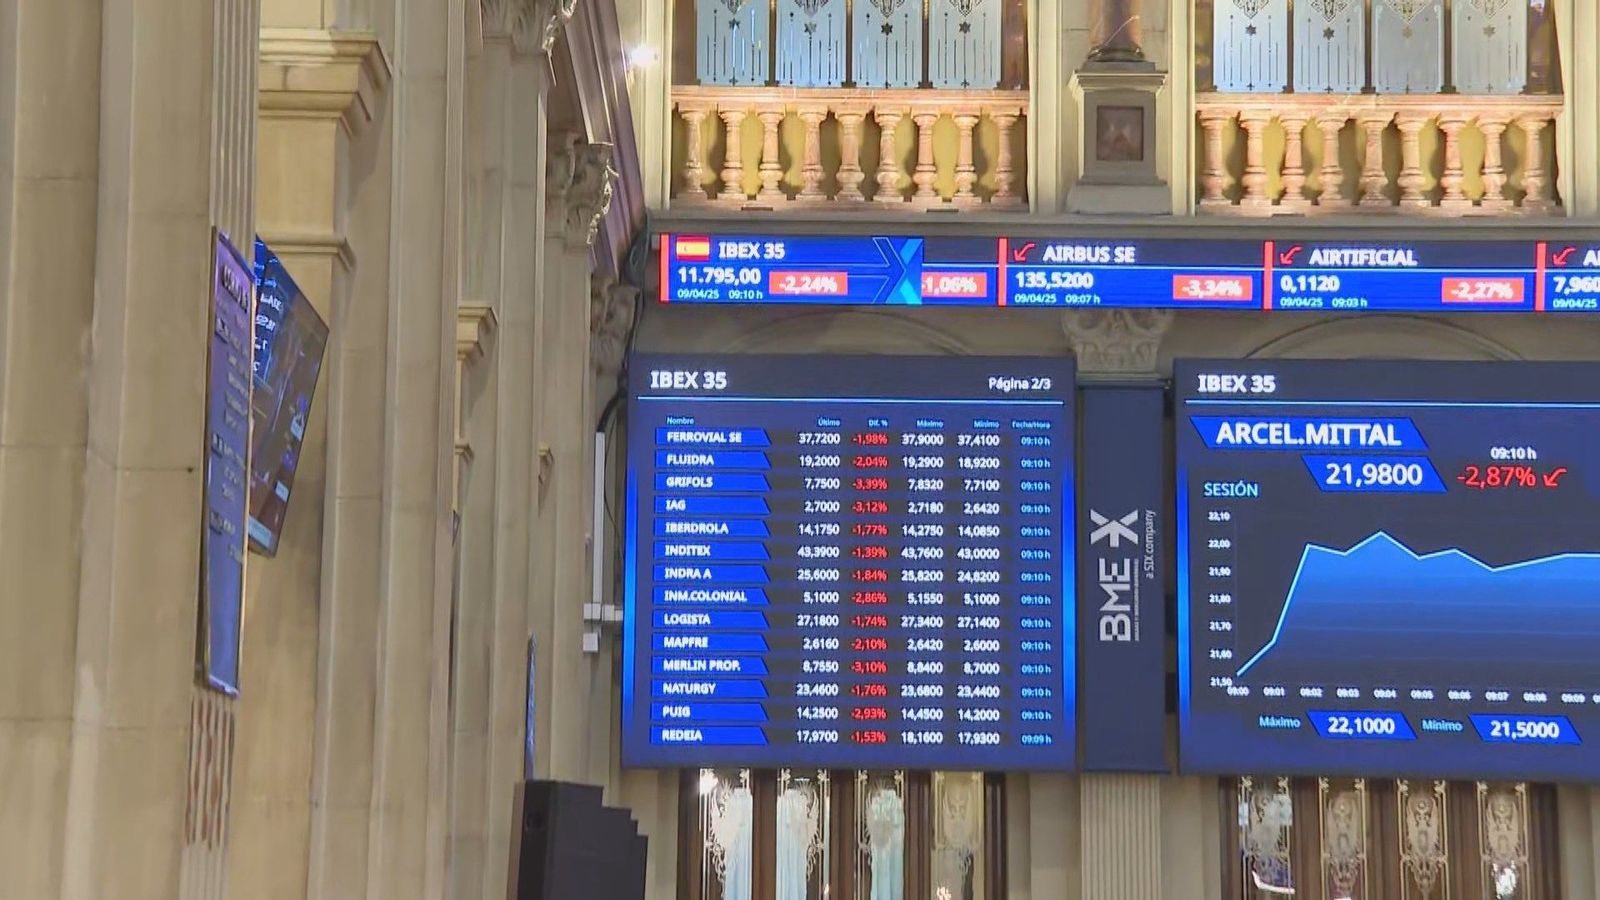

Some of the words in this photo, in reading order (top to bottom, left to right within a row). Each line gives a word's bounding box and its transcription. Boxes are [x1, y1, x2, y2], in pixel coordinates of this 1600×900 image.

[719, 242, 760, 258] IBEX
[764, 243, 785, 259] 35
[1043, 246, 1110, 262] AIRBUS
[1114, 247, 1135, 262] SE
[1309, 249, 1417, 265] AIRTIFICIAL
[679, 267, 761, 285] 11.795,00
[1016, 272, 1093, 289] 135,5200
[1281, 276, 1340, 293] 0,1120
[779, 276, 837, 294] -2,24%
[1183, 280, 1242, 298] -3,34%
[1452, 282, 1513, 301] -2,27%
[677, 288, 720, 300] 09/04/25
[728, 289, 755, 300] 09:10
[756, 289, 764, 300] h
[1014, 293, 1057, 304] 09/04/25
[1065, 293, 1092, 304] 09:07
[1093, 294, 1101, 304] h
[1279, 296, 1324, 308] 09/04/25
[1331, 297, 1360, 308] 09:03
[1360, 297, 1368, 307] h
[1552, 298, 1598, 308] 09/04/25
[651, 371, 698, 388] IBEX
[703, 372, 726, 389] 35
[989, 377, 1029, 392] Página
[1031, 377, 1052, 390] 2/3
[1198, 375, 1246, 392] IBEX
[1251, 375, 1275, 392] 35
[666, 416, 695, 425] Nombre
[817, 417, 841, 427] Último
[916, 419, 944, 428] Máximo
[666, 431, 727, 443] FERROVIAL
[728, 431, 742, 443] SE
[798, 432, 841, 446] 37,7200
[901, 433, 944, 446] 37,9000
[957, 434, 1000, 447] 37,4100
[1021, 436, 1044, 446] 09:10
[1216, 423, 1401, 445] ARCEL.MITTAL
[666, 453, 715, 466] FLUIDRA
[799, 455, 841, 468] 19,2000
[902, 456, 944, 470] 19,2900
[958, 456, 1000, 470] 18,9200
[1021, 459, 1044, 468] 09:10
[1490, 446, 1526, 460] 09:10
[1526, 446, 1537, 460] h
[666, 476, 714, 488] GRIFOLS
[804, 477, 841, 490] 7,7500
[964, 479, 1000, 492] 7,7100
[1020, 481, 1044, 491] 09:10
[1327, 464, 1422, 487] 21,9800
[1458, 467, 1536, 488] -2,87%
[1205, 481, 1257, 496] SESIÓN
[665, 499, 687, 511] IAG
[804, 500, 840, 513] 2,7000
[963, 502, 1000, 515] 2,6420
[1020, 504, 1044, 514] 09:10
[665, 521, 729, 535] IBERDROLA
[798, 523, 840, 537] 14,1750
[1021, 527, 1044, 536] 09:10
[1145, 509, 1157, 554] company
[664, 544, 711, 556] INDITEX
[797, 546, 840, 559] 43,3900
[901, 546, 944, 560] 43,7600
[956, 547, 1000, 561] 43,0000
[1020, 550, 1044, 559] 09:10
[1143, 554, 1155, 571] SIX
[664, 567, 702, 579] INDRA
[702, 568, 712, 579] A
[797, 568, 840, 582] 25,6000
[1021, 573, 1044, 582] 09:10
[664, 590, 748, 602] INM.COLONIAL
[803, 591, 840, 605] 5,1000
[907, 592, 944, 605] 5,1550
[963, 593, 1000, 606] 5,1000
[1020, 595, 1044, 605] 09:10
[1099, 558, 1130, 641] BME
[664, 613, 711, 625] LOGISTA
[797, 614, 840, 628] 27,1800
[900, 615, 944, 628] 27,3400
[957, 616, 1000, 630] 27,1400
[1021, 618, 1044, 628] 09:10
[663, 636, 709, 648] MAPFRE
[803, 637, 840, 651] 2,6160
[907, 638, 944, 652] 2,6420
[963, 639, 1000, 653] 2,6000
[1021, 641, 1044, 651] 09:10
[663, 659, 707, 671] MERLIN
[709, 659, 741, 671] PROP.
[802, 660, 839, 673] 8,7550
[906, 661, 944, 675] 8,8400
[963, 661, 1000, 675] 8,7000
[1021, 664, 1044, 674] 09:10
[662, 682, 717, 695] NATURGY
[796, 683, 839, 697] 23,4600
[956, 685, 1001, 699] 23,4400
[1021, 688, 1044, 697] 09:10
[662, 705, 691, 718] PUIG
[797, 706, 839, 720] 14,2500
[901, 708, 944, 721] 14,4500
[958, 708, 1000, 722] 14,2000
[1021, 711, 1044, 720] 09:10
[1259, 716, 1301, 728] Máximo
[1329, 717, 1395, 734] 22,1000
[1491, 721, 1559, 739] 21,5000
[661, 729, 703, 741] REDEIA
[796, 729, 839, 743] 17,9700
[958, 731, 1000, 745] 17,9300
[1021, 734, 1044, 744] 09:09
